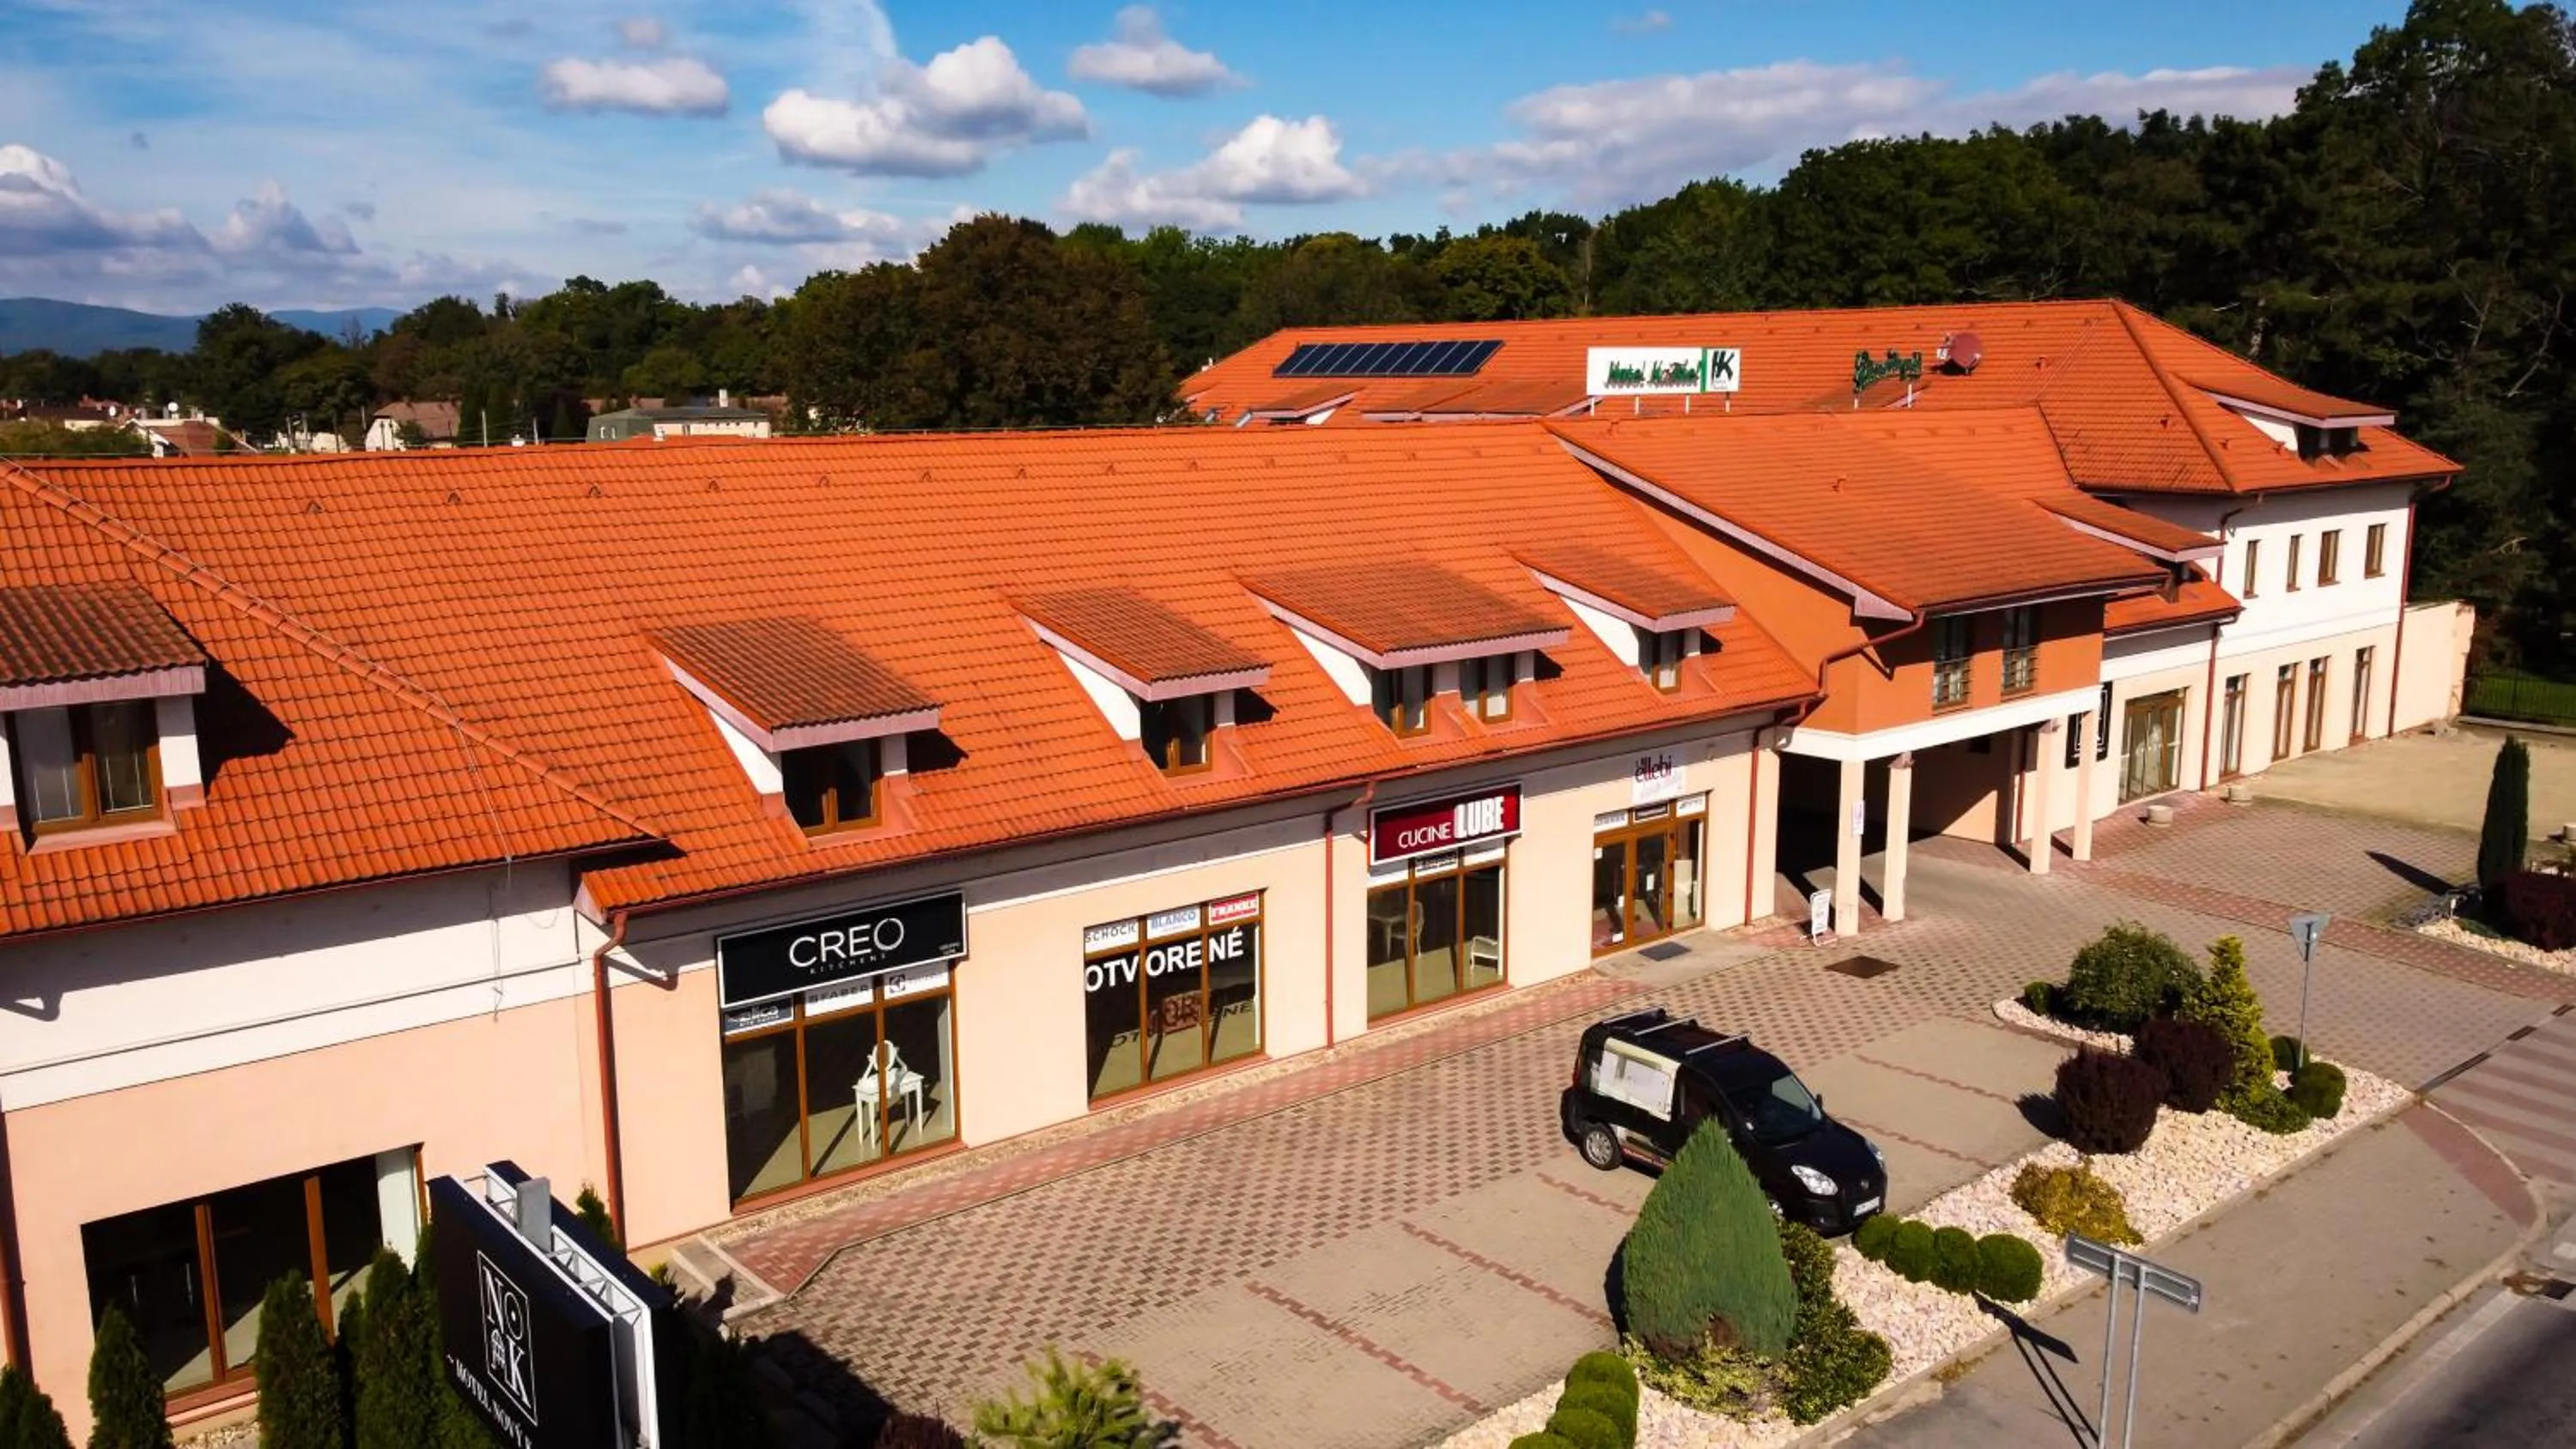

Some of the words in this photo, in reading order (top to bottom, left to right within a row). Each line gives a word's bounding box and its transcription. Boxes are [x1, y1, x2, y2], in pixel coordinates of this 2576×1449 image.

[1398, 822, 1451, 848] CUCINE
[1454, 796, 1504, 839] LUBE
[789, 918, 905, 967] CREO
[1085, 922, 1137, 943] SCHOCK
[1151, 910, 1196, 930] BLANCO
[1084, 926, 1244, 992] OTVORENÉ
